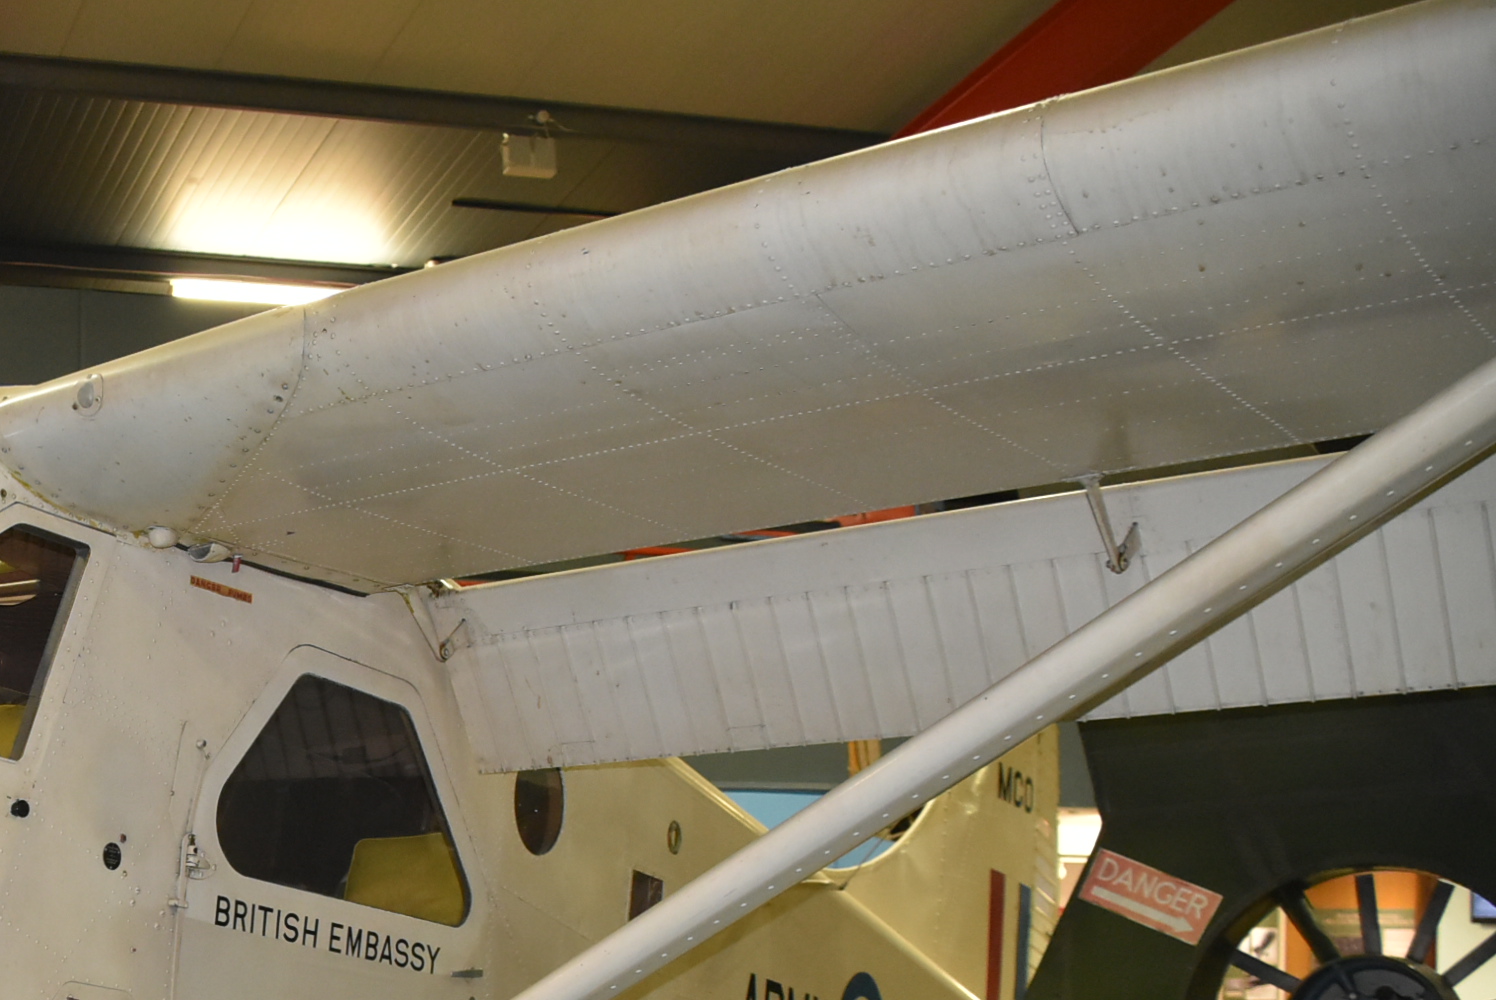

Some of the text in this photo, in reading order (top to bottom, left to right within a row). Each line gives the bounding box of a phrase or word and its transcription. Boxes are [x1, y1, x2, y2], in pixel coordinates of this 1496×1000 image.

[1098, 857, 1209, 919] DANGER
[214, 895, 441, 975] BRITISH EMBASSY
